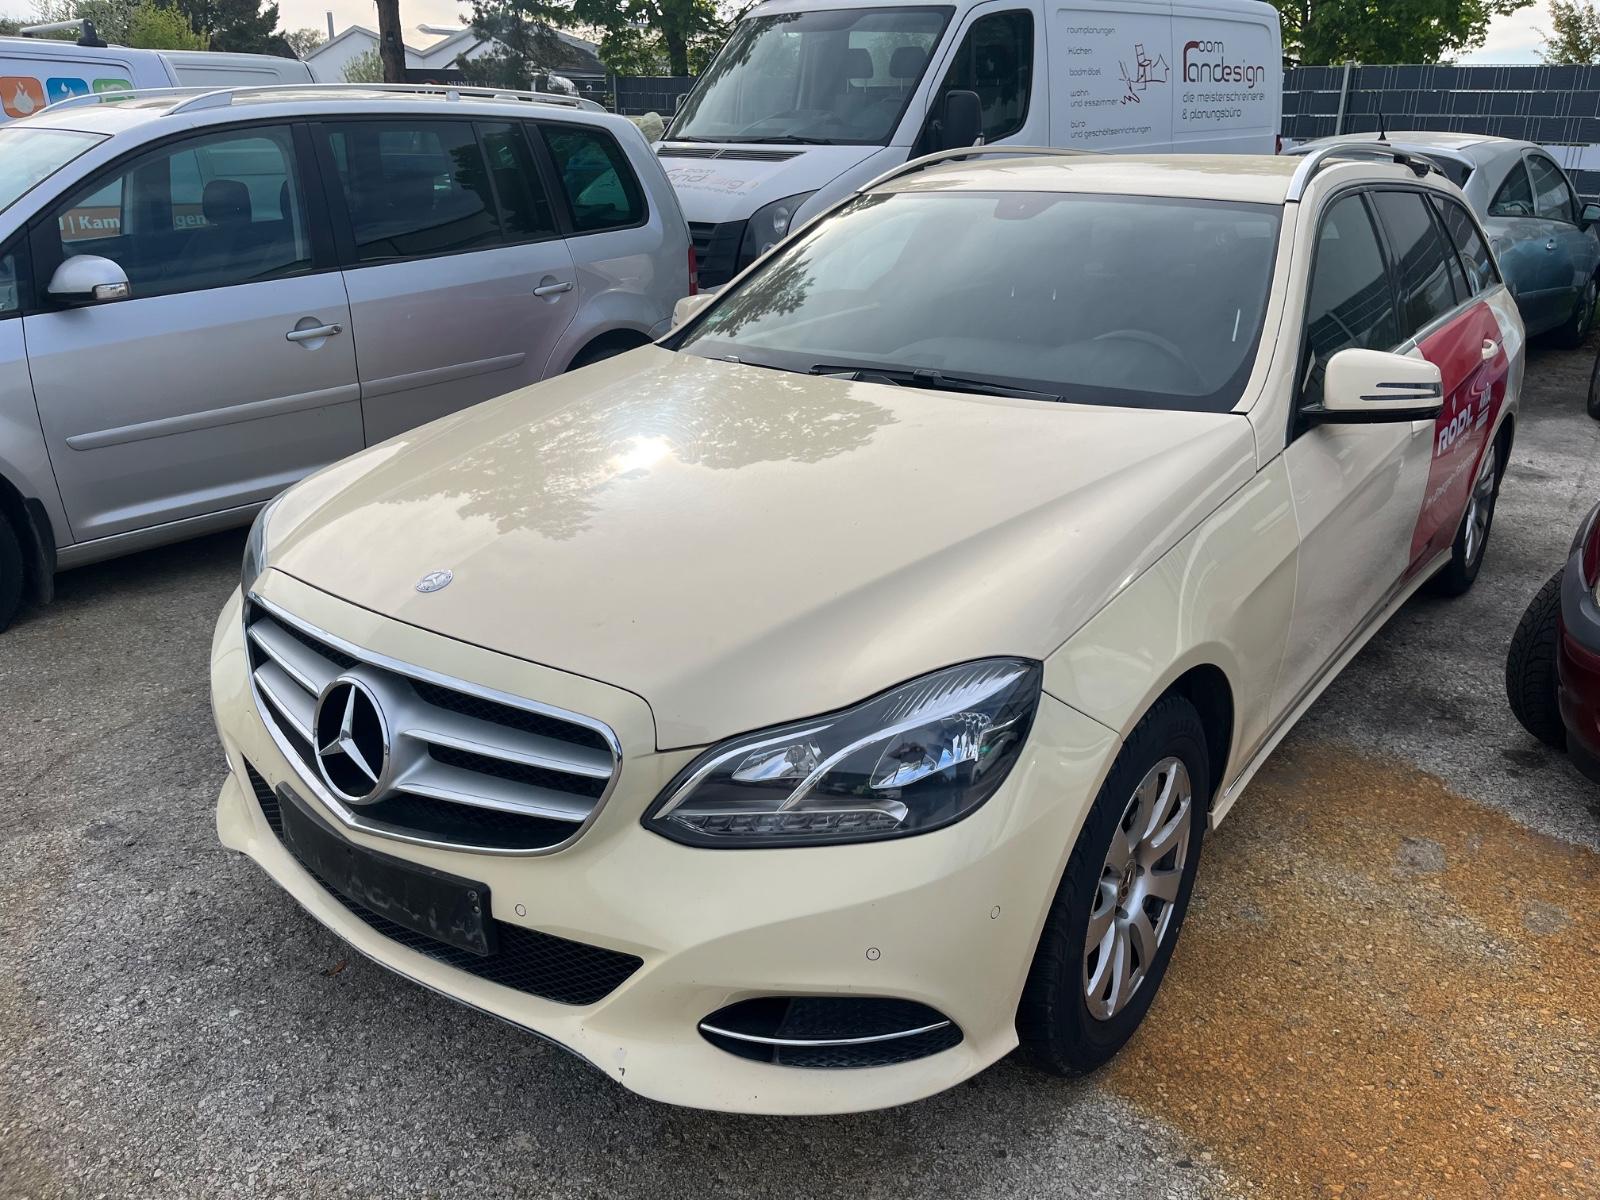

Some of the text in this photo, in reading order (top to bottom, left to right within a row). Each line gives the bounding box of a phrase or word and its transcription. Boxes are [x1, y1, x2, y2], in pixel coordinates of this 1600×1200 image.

[1182, 92, 1195, 103] die
[78, 215, 120, 230] Kam
[174, 214, 207, 227] gen
